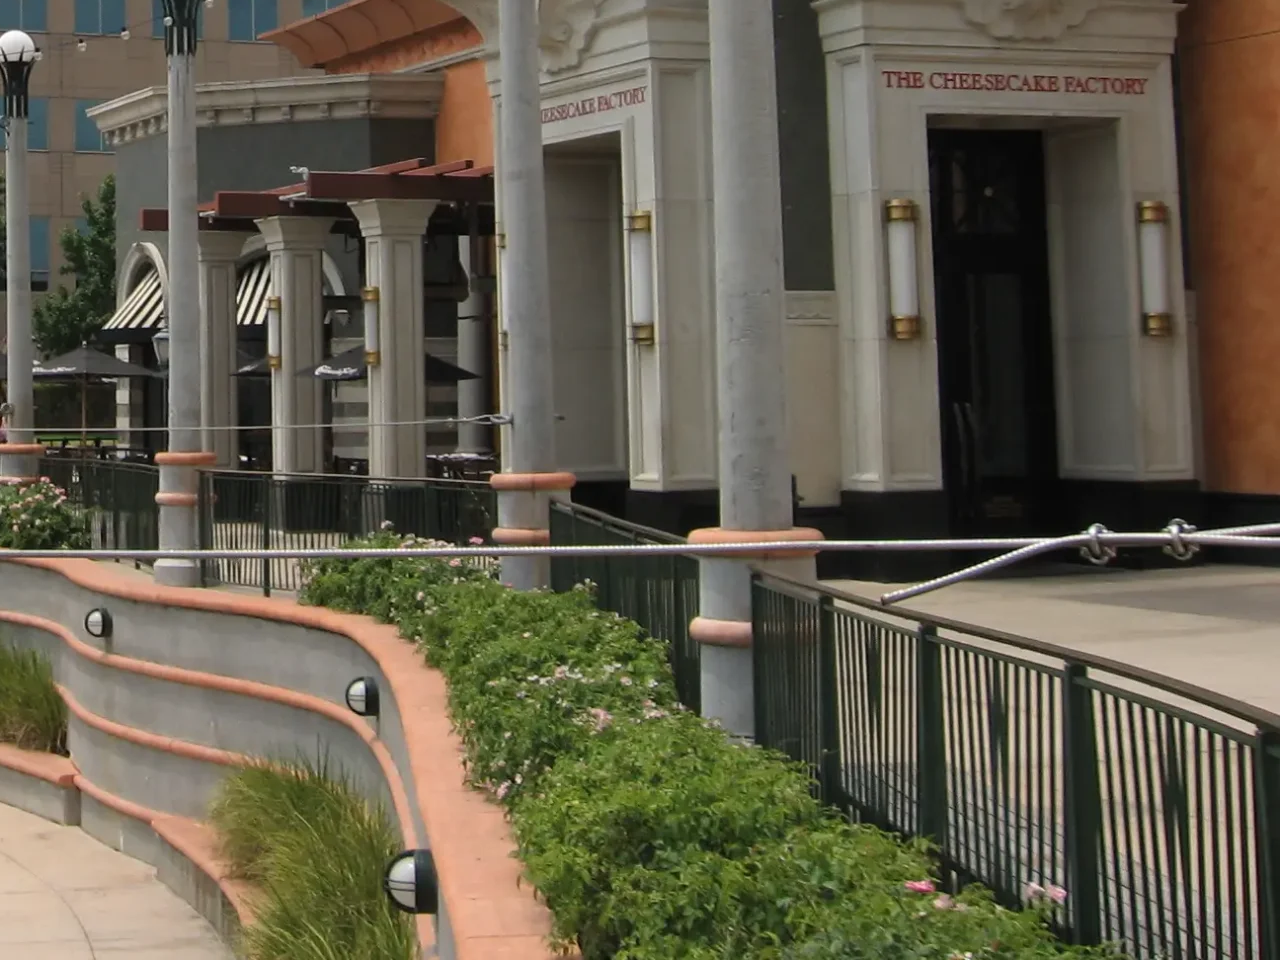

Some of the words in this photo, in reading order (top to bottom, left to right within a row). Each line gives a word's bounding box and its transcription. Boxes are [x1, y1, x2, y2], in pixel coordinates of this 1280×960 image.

[881, 71, 924, 89] THE
[929, 72, 1059, 92] CHEESECAKE
[1063, 76, 1148, 94] FACTORY
[596, 86, 648, 112] FACTORY
